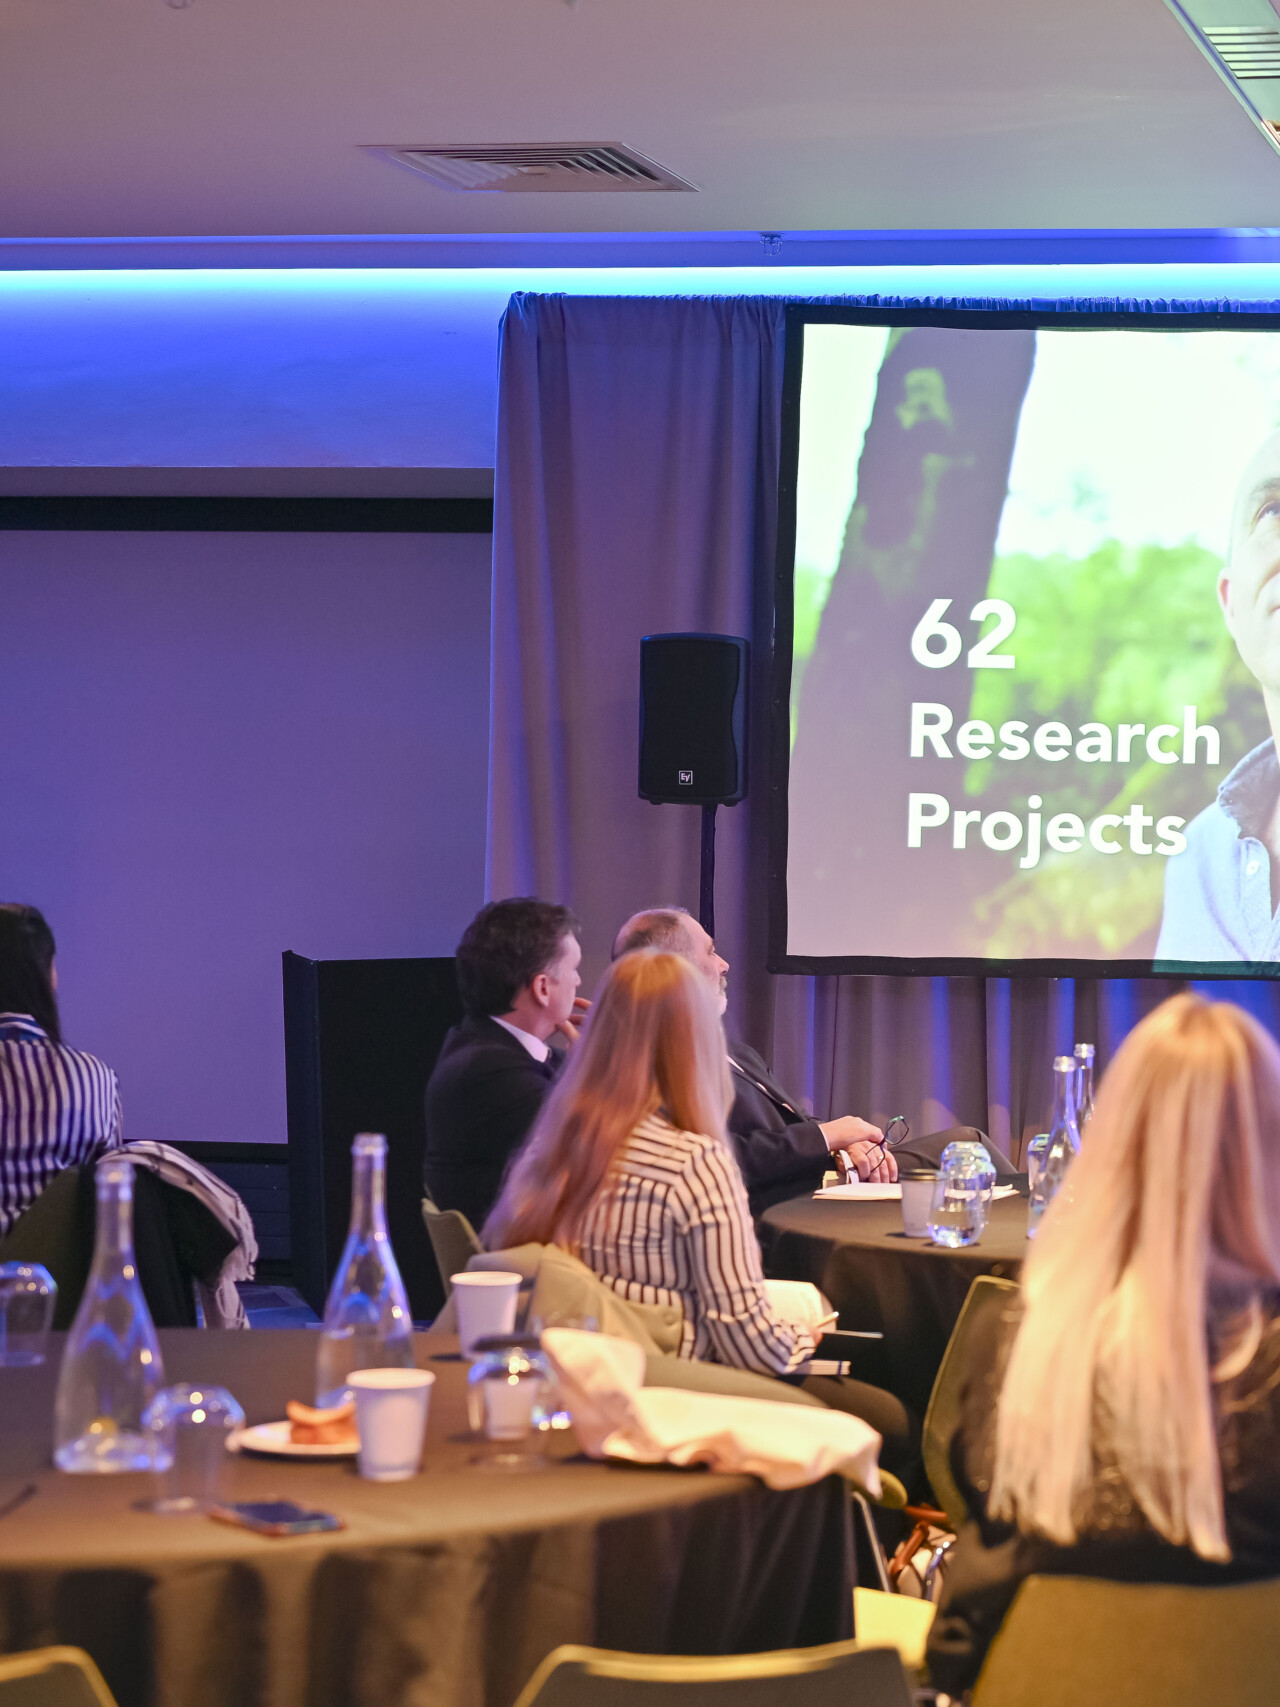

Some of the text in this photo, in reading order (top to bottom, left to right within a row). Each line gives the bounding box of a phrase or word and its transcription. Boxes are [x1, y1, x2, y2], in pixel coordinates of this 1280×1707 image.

[910, 598, 1017, 669] 62
[909, 701, 1221, 764] Research
[907, 792, 1188, 869] Projects
